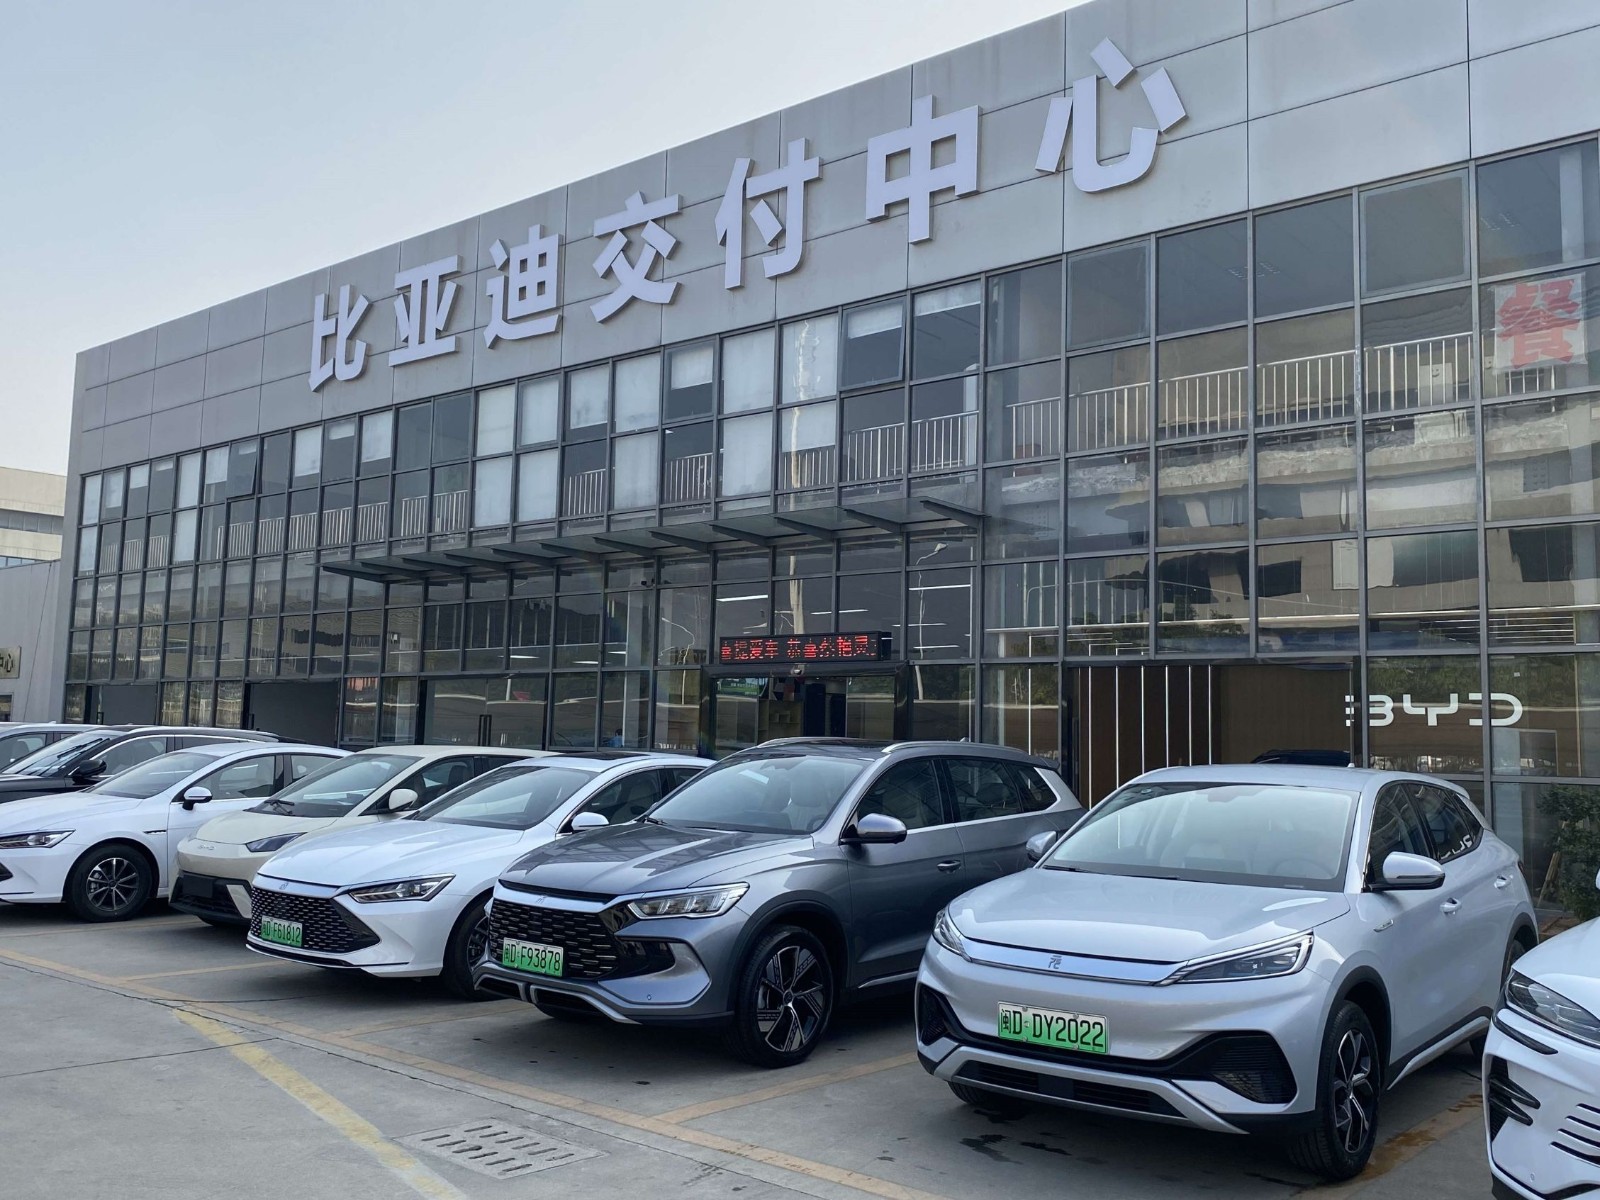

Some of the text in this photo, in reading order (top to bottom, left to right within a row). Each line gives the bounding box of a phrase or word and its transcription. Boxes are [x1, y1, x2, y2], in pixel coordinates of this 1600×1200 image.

[309, 37, 1188, 392] 比亚迪交付中心
[1345, 692, 1524, 727] BYD
